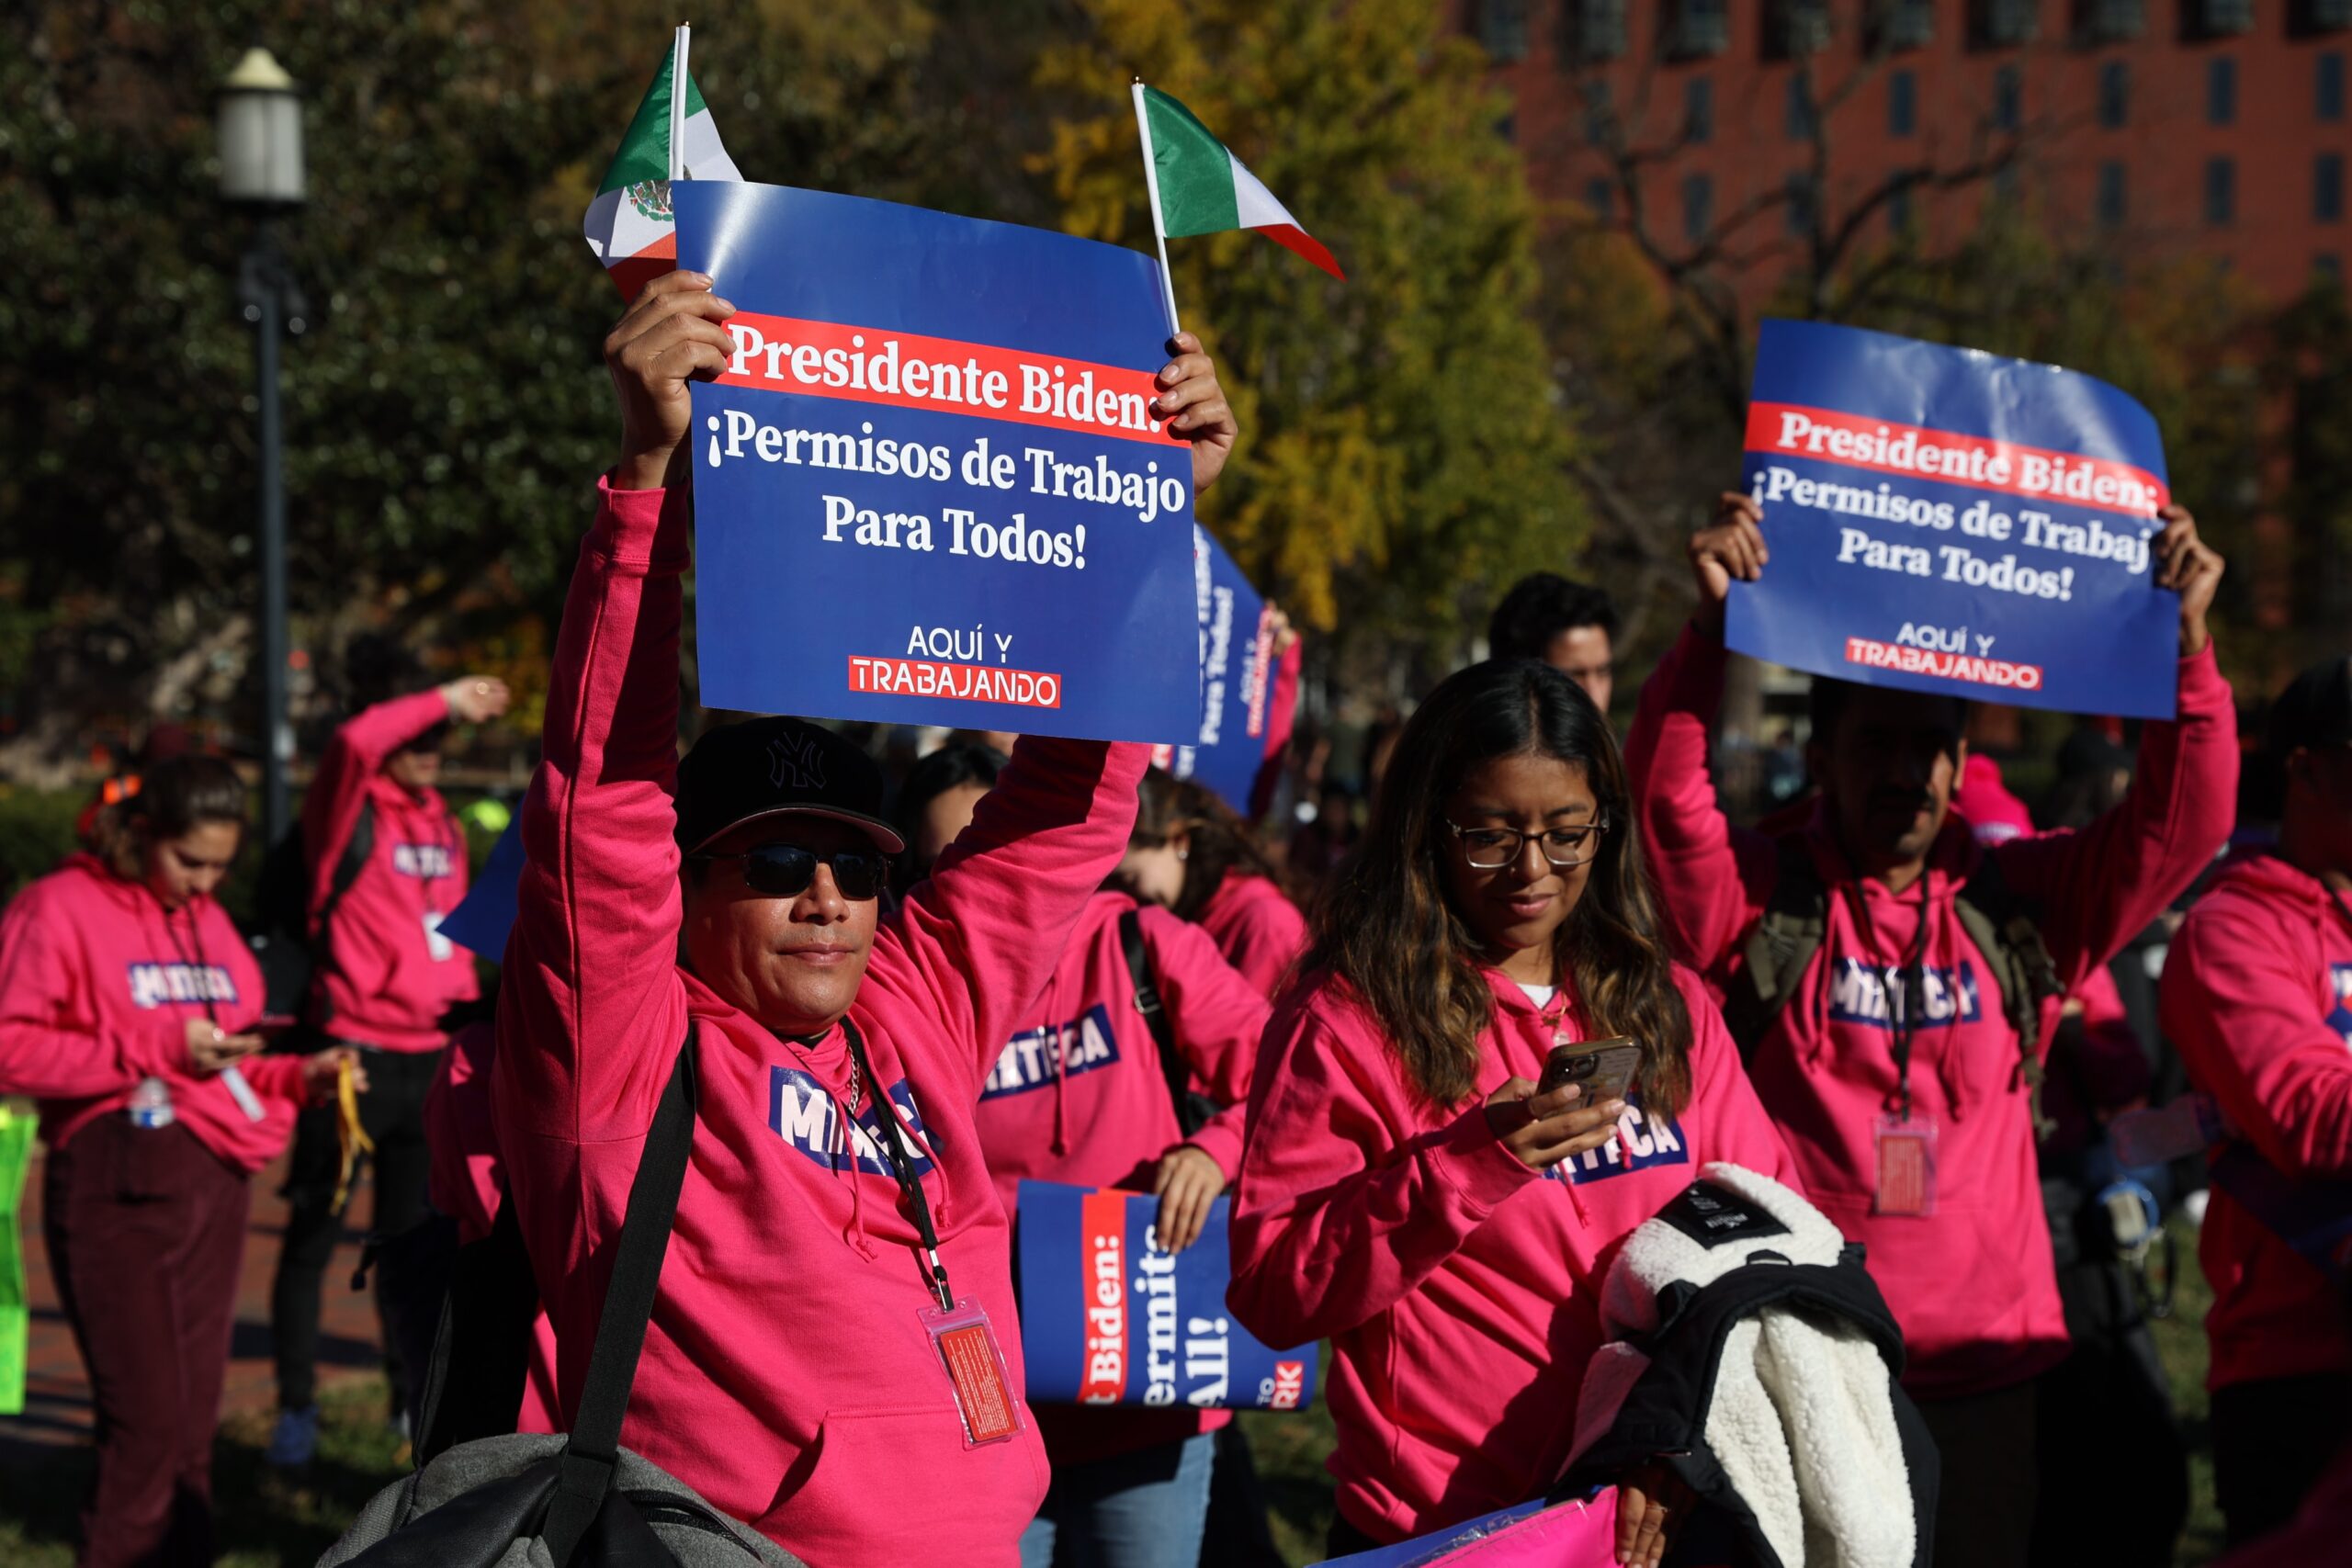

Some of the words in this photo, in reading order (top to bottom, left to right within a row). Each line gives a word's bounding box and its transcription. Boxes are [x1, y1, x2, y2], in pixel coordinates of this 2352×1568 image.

[728, 323, 1009, 409] Presidente
[1019, 364, 1161, 434] Biden:
[707, 409, 952, 481] ¡Permisos
[961, 437, 1016, 490] de
[1024, 446, 1185, 523] Trabajo
[1779, 412, 2015, 485] Presidente
[2017, 453, 2158, 520] Biden:
[821, 494, 934, 552] Para
[943, 508, 1086, 570] Todos!
[1752, 467, 1955, 530] ¡Permisos
[1960, 500, 2013, 541] de
[2018, 510, 2153, 574] Trabaj
[1838, 527, 1931, 577] Para
[1939, 545, 2075, 602] Todos!
[907, 623, 983, 661] AQUÍ
[994, 633, 1012, 663] Y
[1849, 638, 2039, 689] TRABAJANDO
[1895, 622, 1967, 654] AQUÍ
[1975, 634, 1995, 658] Y
[853, 659, 1057, 705] TRABAJANDO
[1089, 1235, 1123, 1383] Biden:
